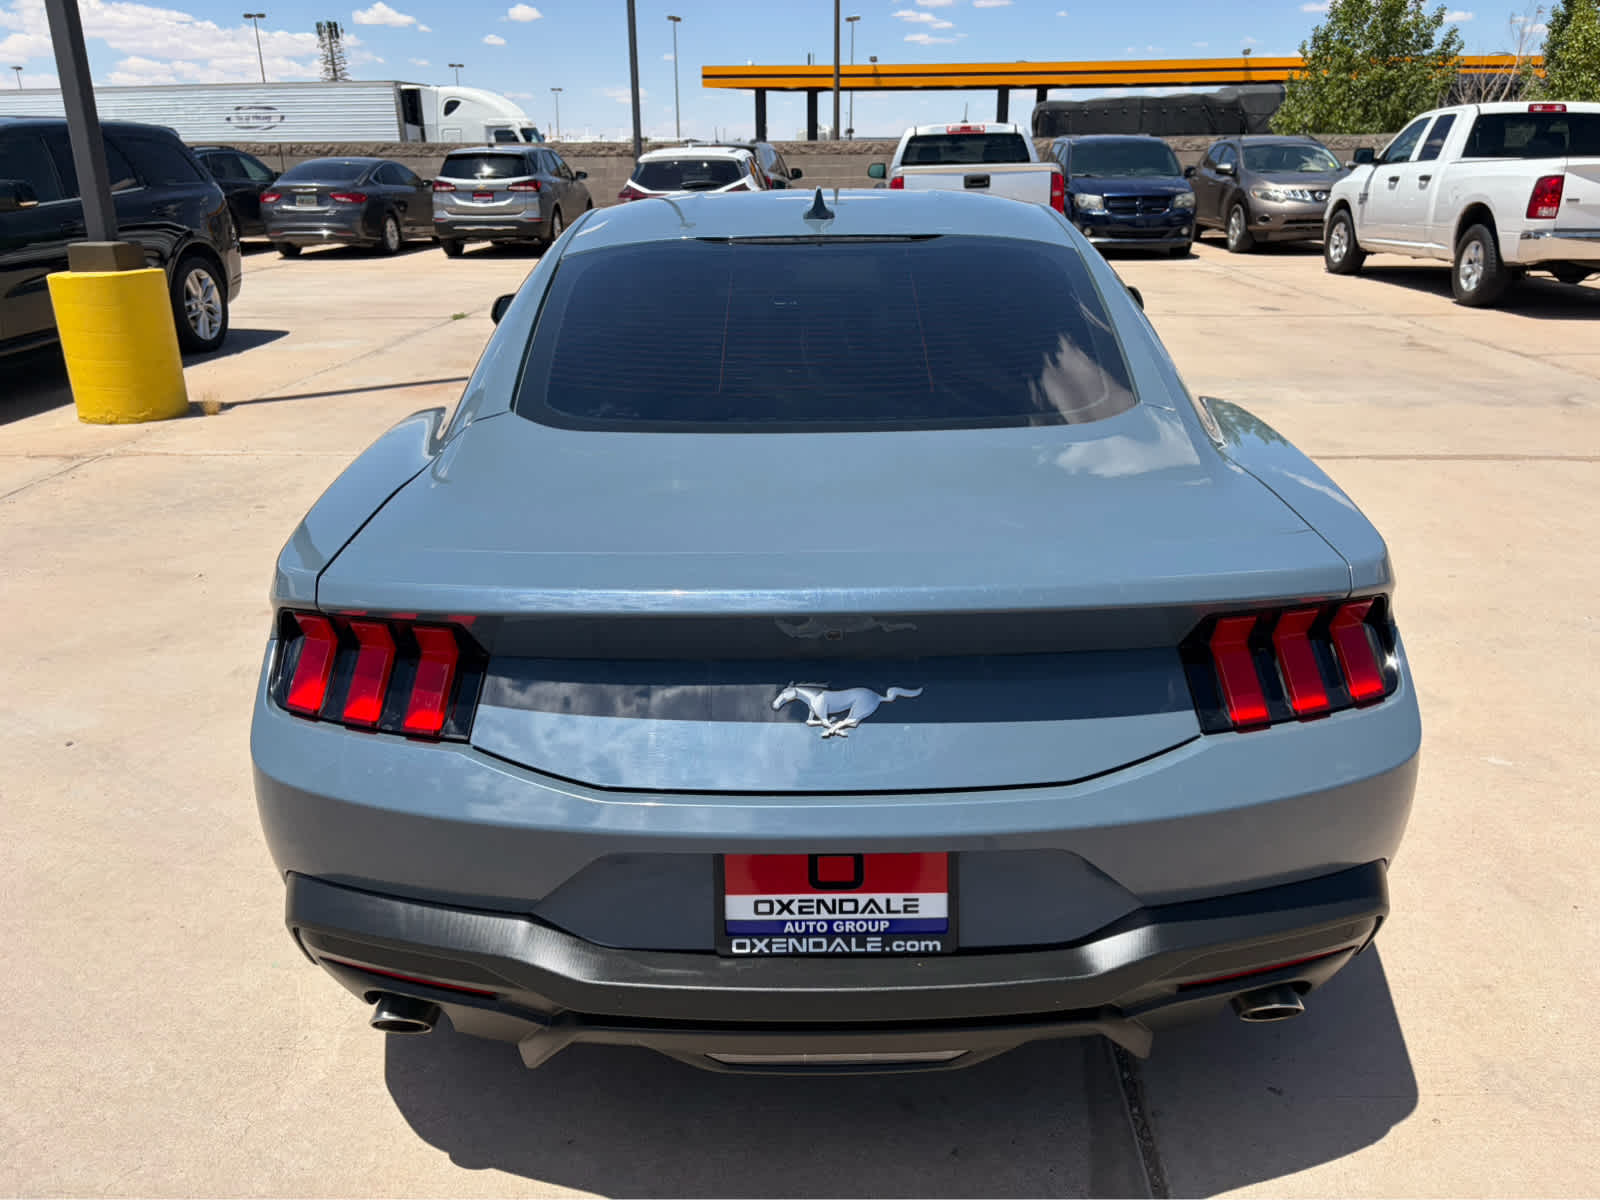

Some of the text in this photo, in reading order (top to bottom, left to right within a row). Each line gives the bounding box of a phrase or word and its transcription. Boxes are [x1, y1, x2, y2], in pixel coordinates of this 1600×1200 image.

[753, 898, 920, 916] OXENDALE
[784, 920, 889, 933] AUTO GROUP
[731, 937, 942, 954] OXENDALE.com
